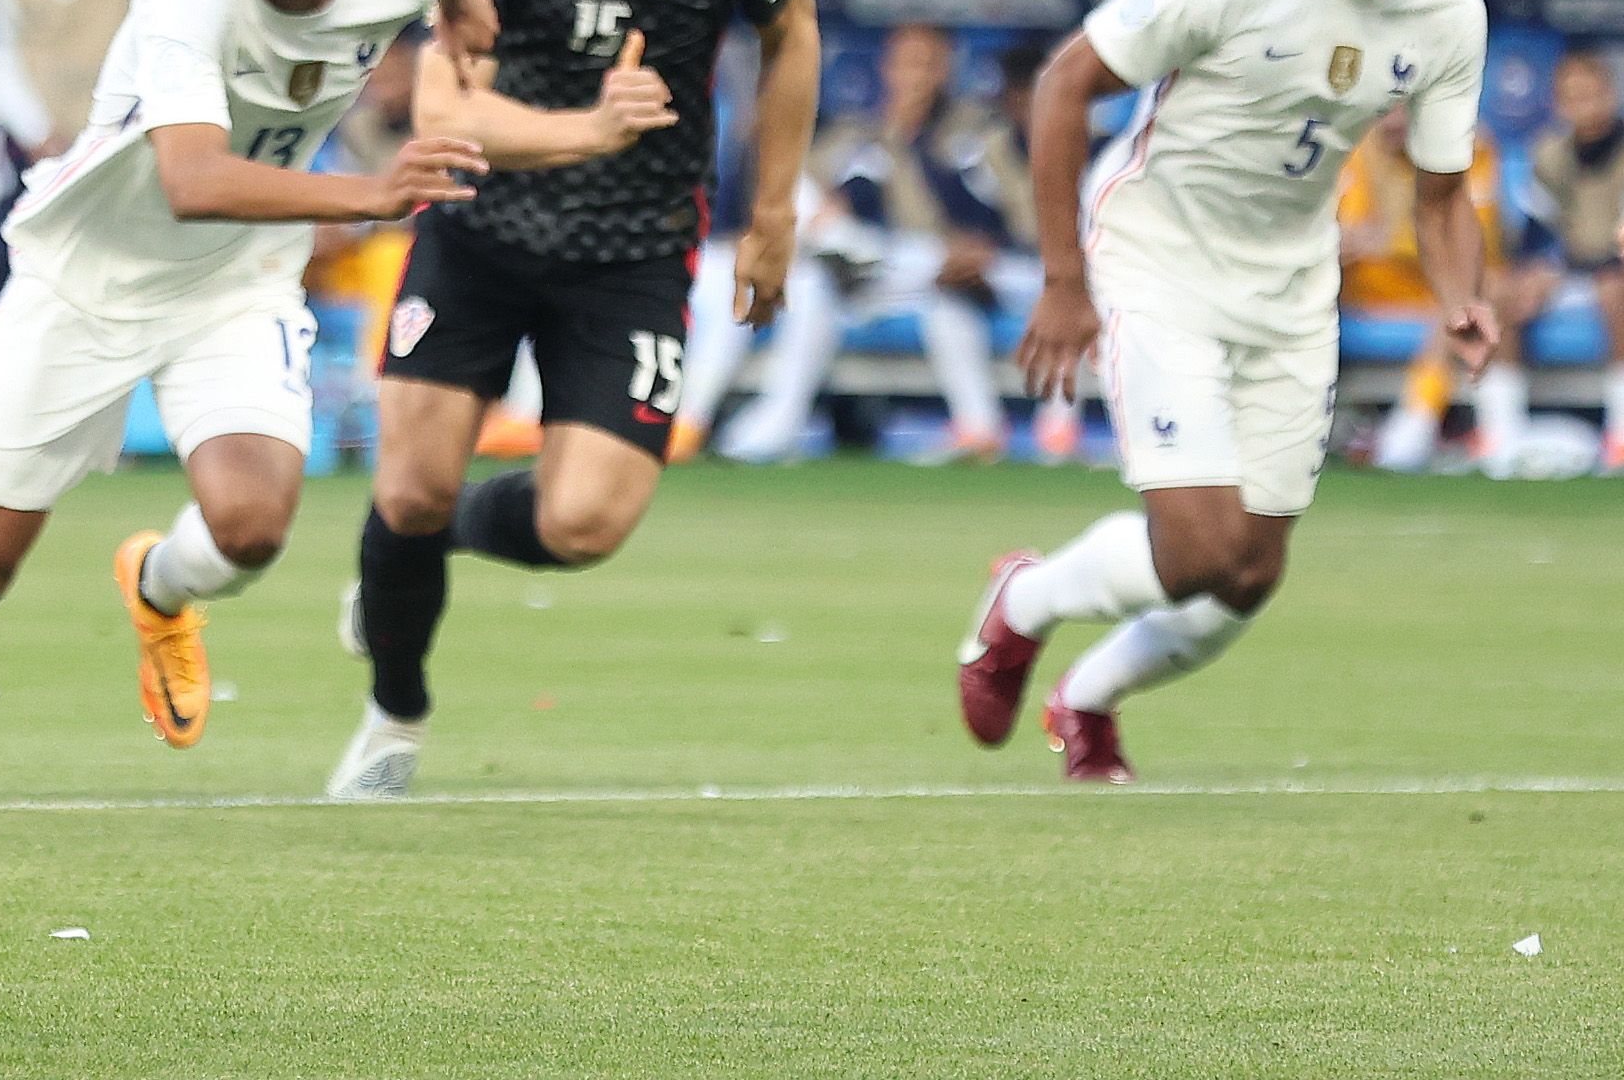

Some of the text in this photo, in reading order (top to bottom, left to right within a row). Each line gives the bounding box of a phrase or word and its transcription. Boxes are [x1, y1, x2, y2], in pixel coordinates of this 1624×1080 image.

[246, 126, 304, 169] 13
[1282, 119, 1331, 178] 5
[627, 329, 684, 414] 15
